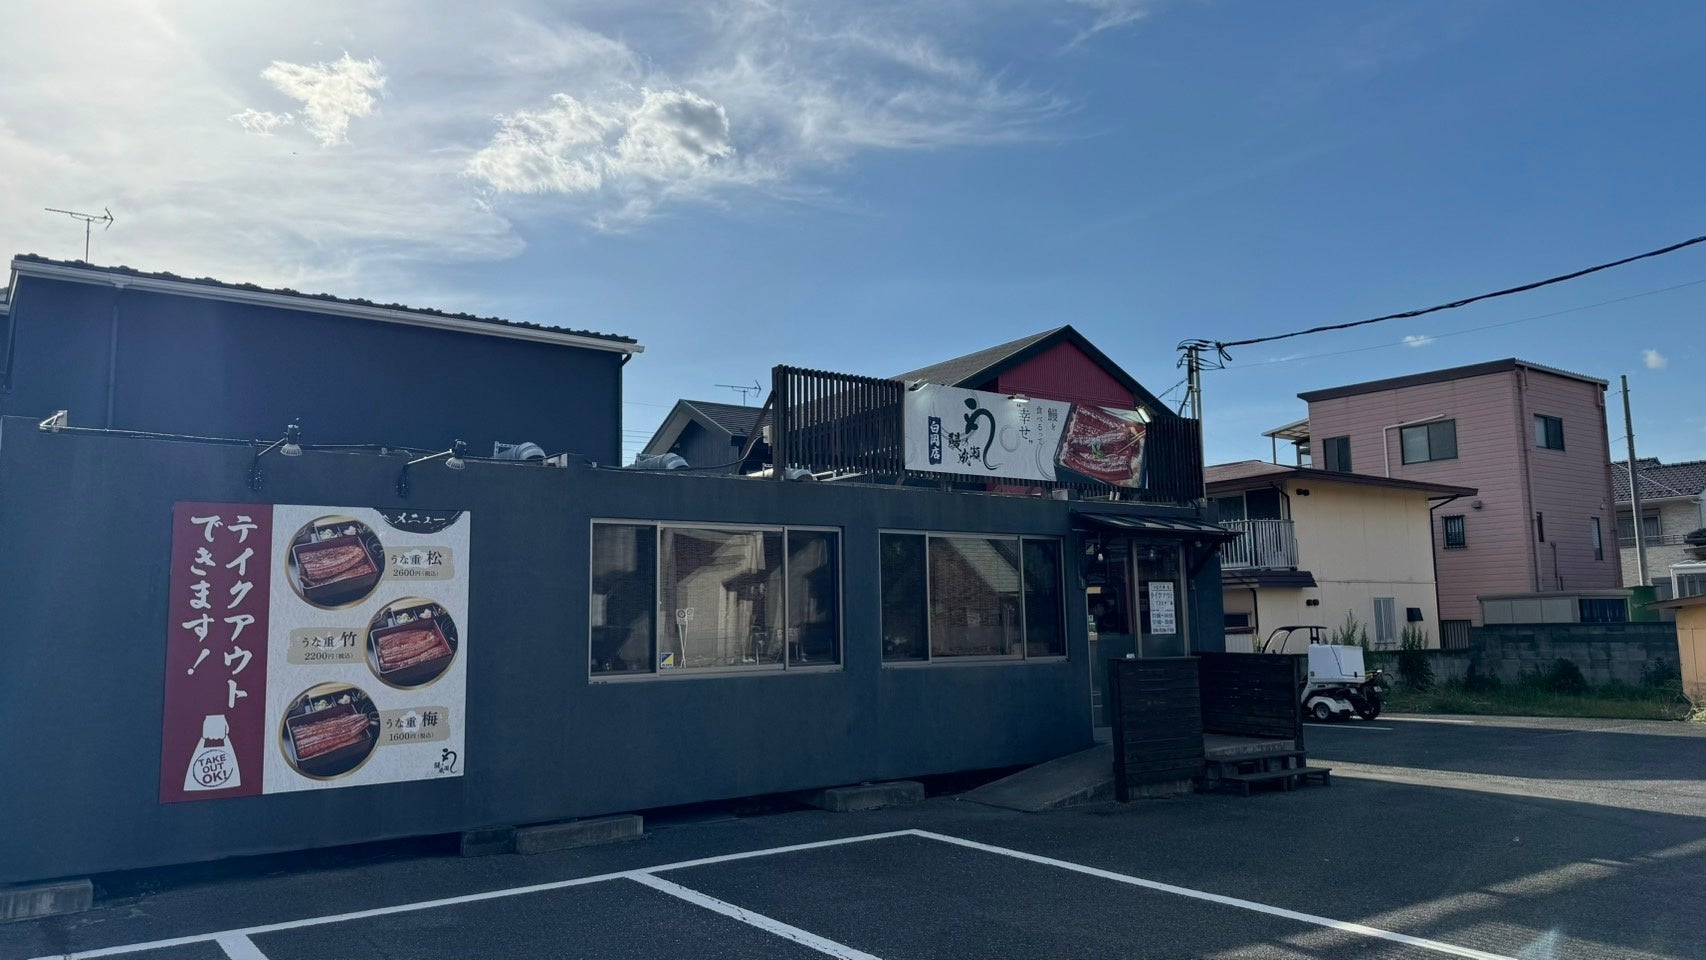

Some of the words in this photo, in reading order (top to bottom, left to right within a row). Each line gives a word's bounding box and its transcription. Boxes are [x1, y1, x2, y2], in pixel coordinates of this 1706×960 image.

[394, 512, 446, 524] メニュー
[391, 554, 422, 565] うな重
[427, 550, 442, 565] 松
[182, 515, 223, 675] できます！
[224, 515, 258, 709] テイクアウト
[302, 636, 335, 648] うな重
[339, 631, 357, 647] 竹
[386, 716, 417, 729] うな重
[423, 711, 438, 727] 梅
[198, 754, 227, 767] TAKE
[202, 762, 224, 774] OUT
[202, 770, 227, 784] OK!
